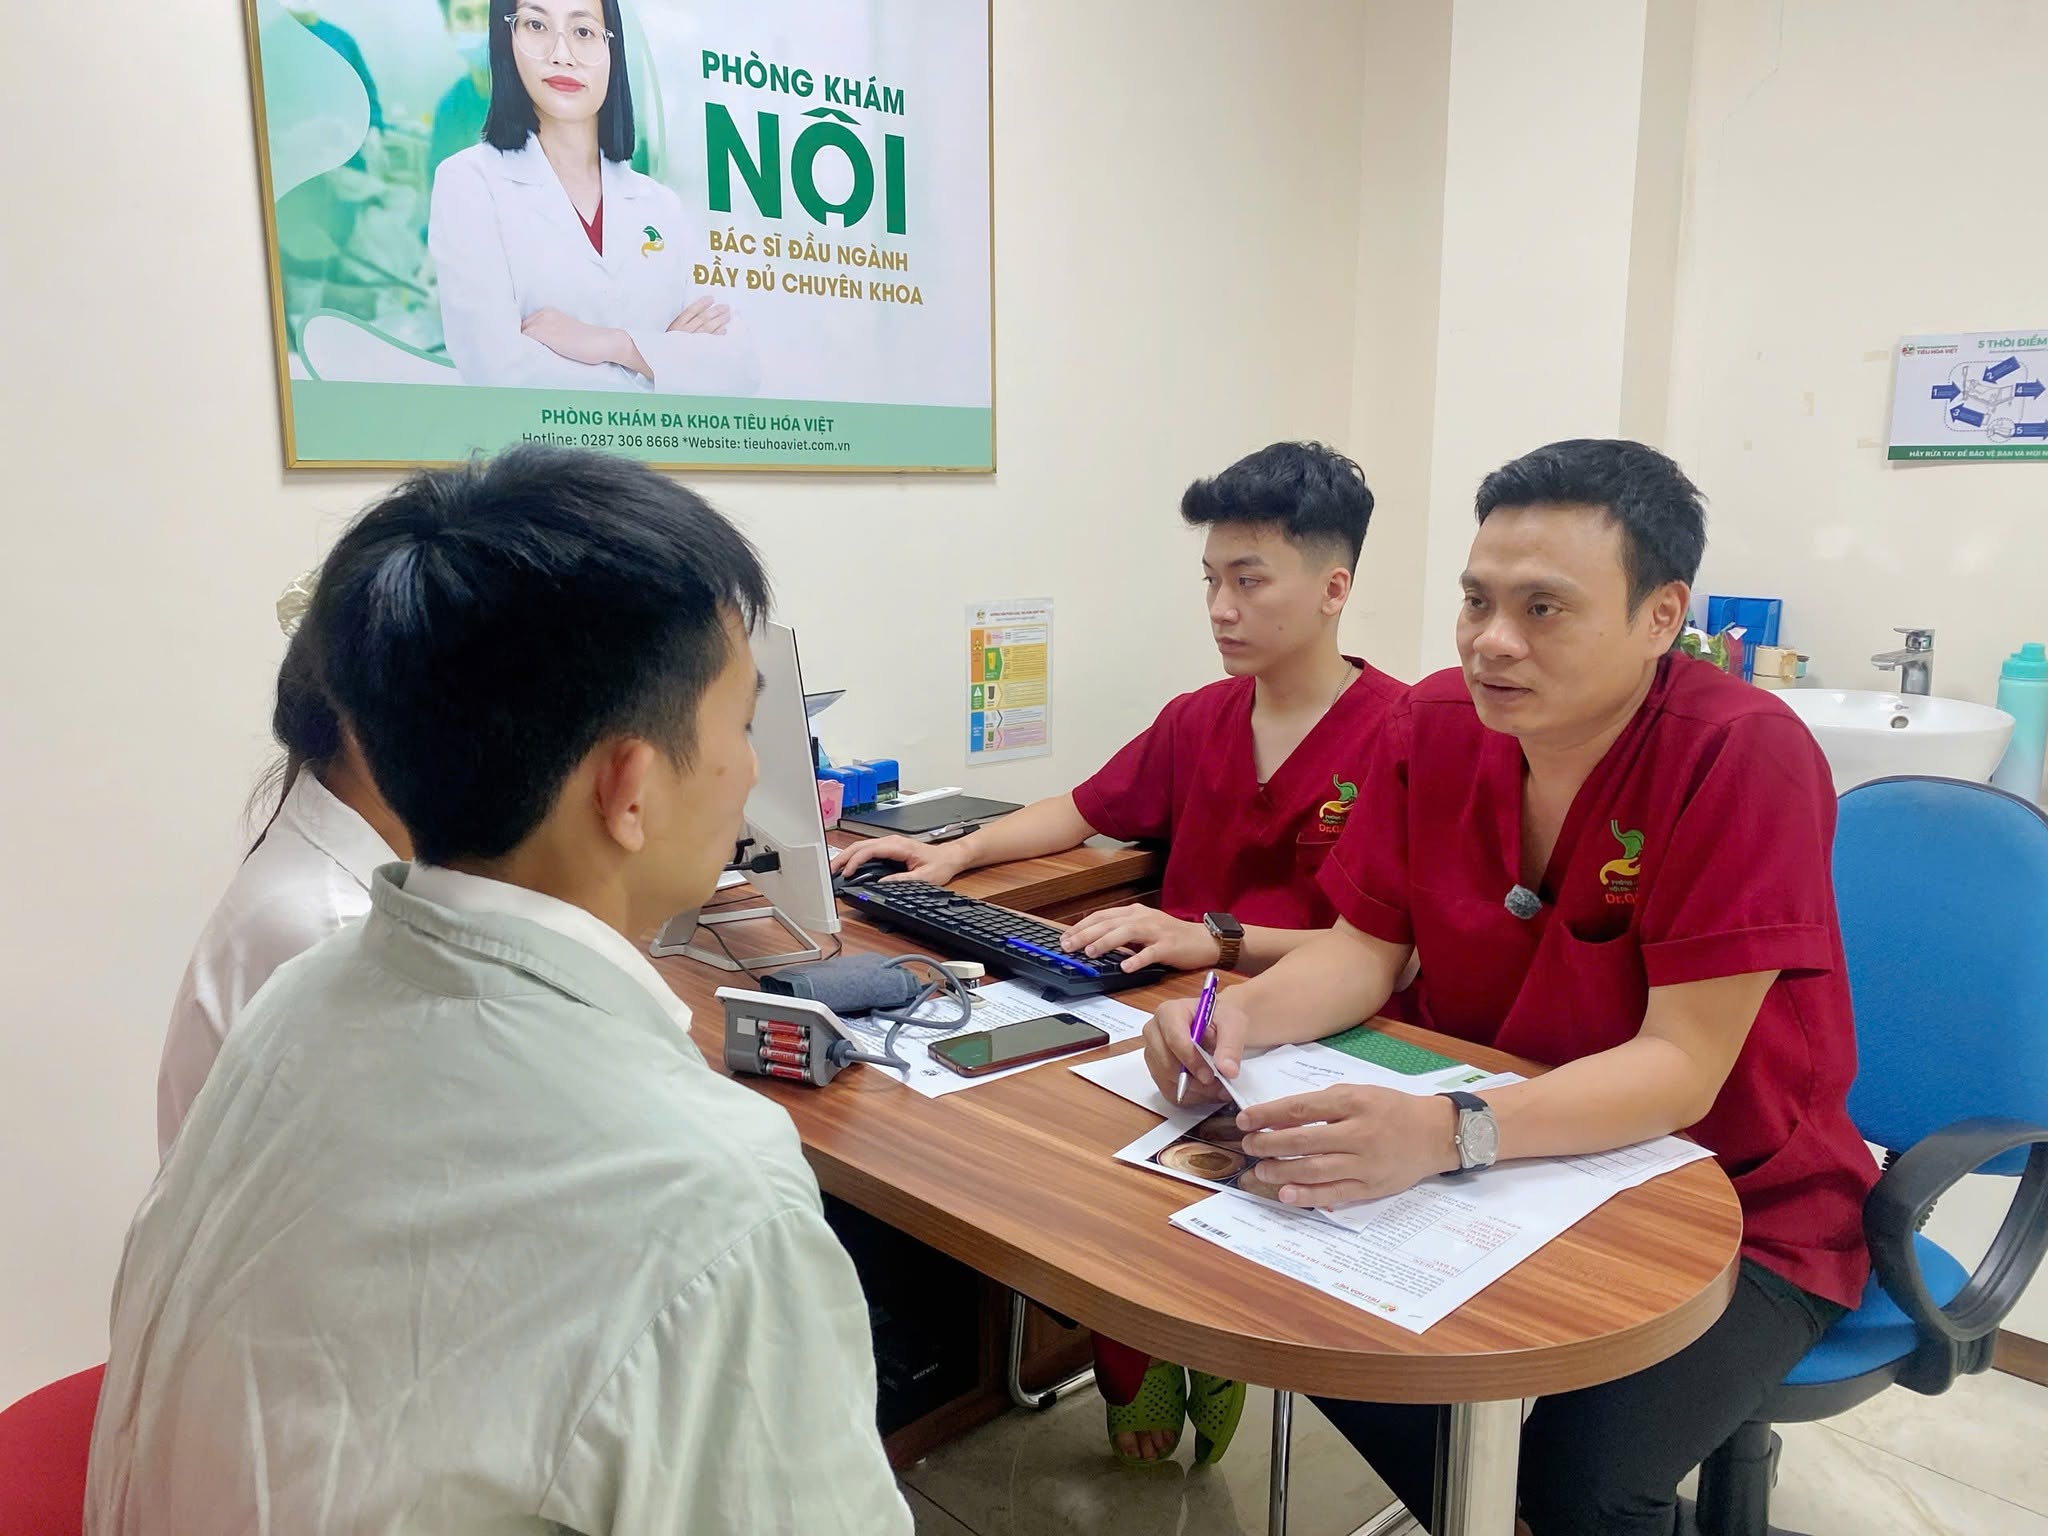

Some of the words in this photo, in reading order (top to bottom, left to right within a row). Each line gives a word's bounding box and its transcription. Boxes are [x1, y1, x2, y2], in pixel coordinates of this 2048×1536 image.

[702, 49, 814, 97] PHÒNG
[824, 74, 905, 116] KHÁM
[705, 102, 906, 235] NỘI
[709, 226, 756, 255] BÁC
[763, 232, 782, 258] SĨ
[788, 231, 831, 263] ĐẦU
[837, 243, 908, 272] NGÀNH
[693, 255, 739, 288] ĐẦY
[746, 263, 775, 292] ĐỦ
[782, 273, 863, 300] CHUYÊN
[869, 281, 924, 305] KHOA
[1978, 340, 1985, 348] 5
[1986, 372, 1994, 380] 2
[1933, 388, 1938, 396] 1
[2016, 386, 2023, 394] 4
[541, 406, 603, 426] PHÒNG
[608, 409, 656, 427] KHÁM
[661, 413, 683, 428] ĐA
[687, 414, 731, 430] KHOA
[733, 413, 767, 431] TIÊU
[770, 414, 801, 432] HÓA
[803, 416, 834, 435] VIỆT
[1952, 408, 1961, 416] 3
[581, 433, 614, 446] 0287
[618, 434, 643, 447] 306
[646, 435, 679, 448] 8668
[743, 437, 851, 451] tieuhoaviet.com.vn
